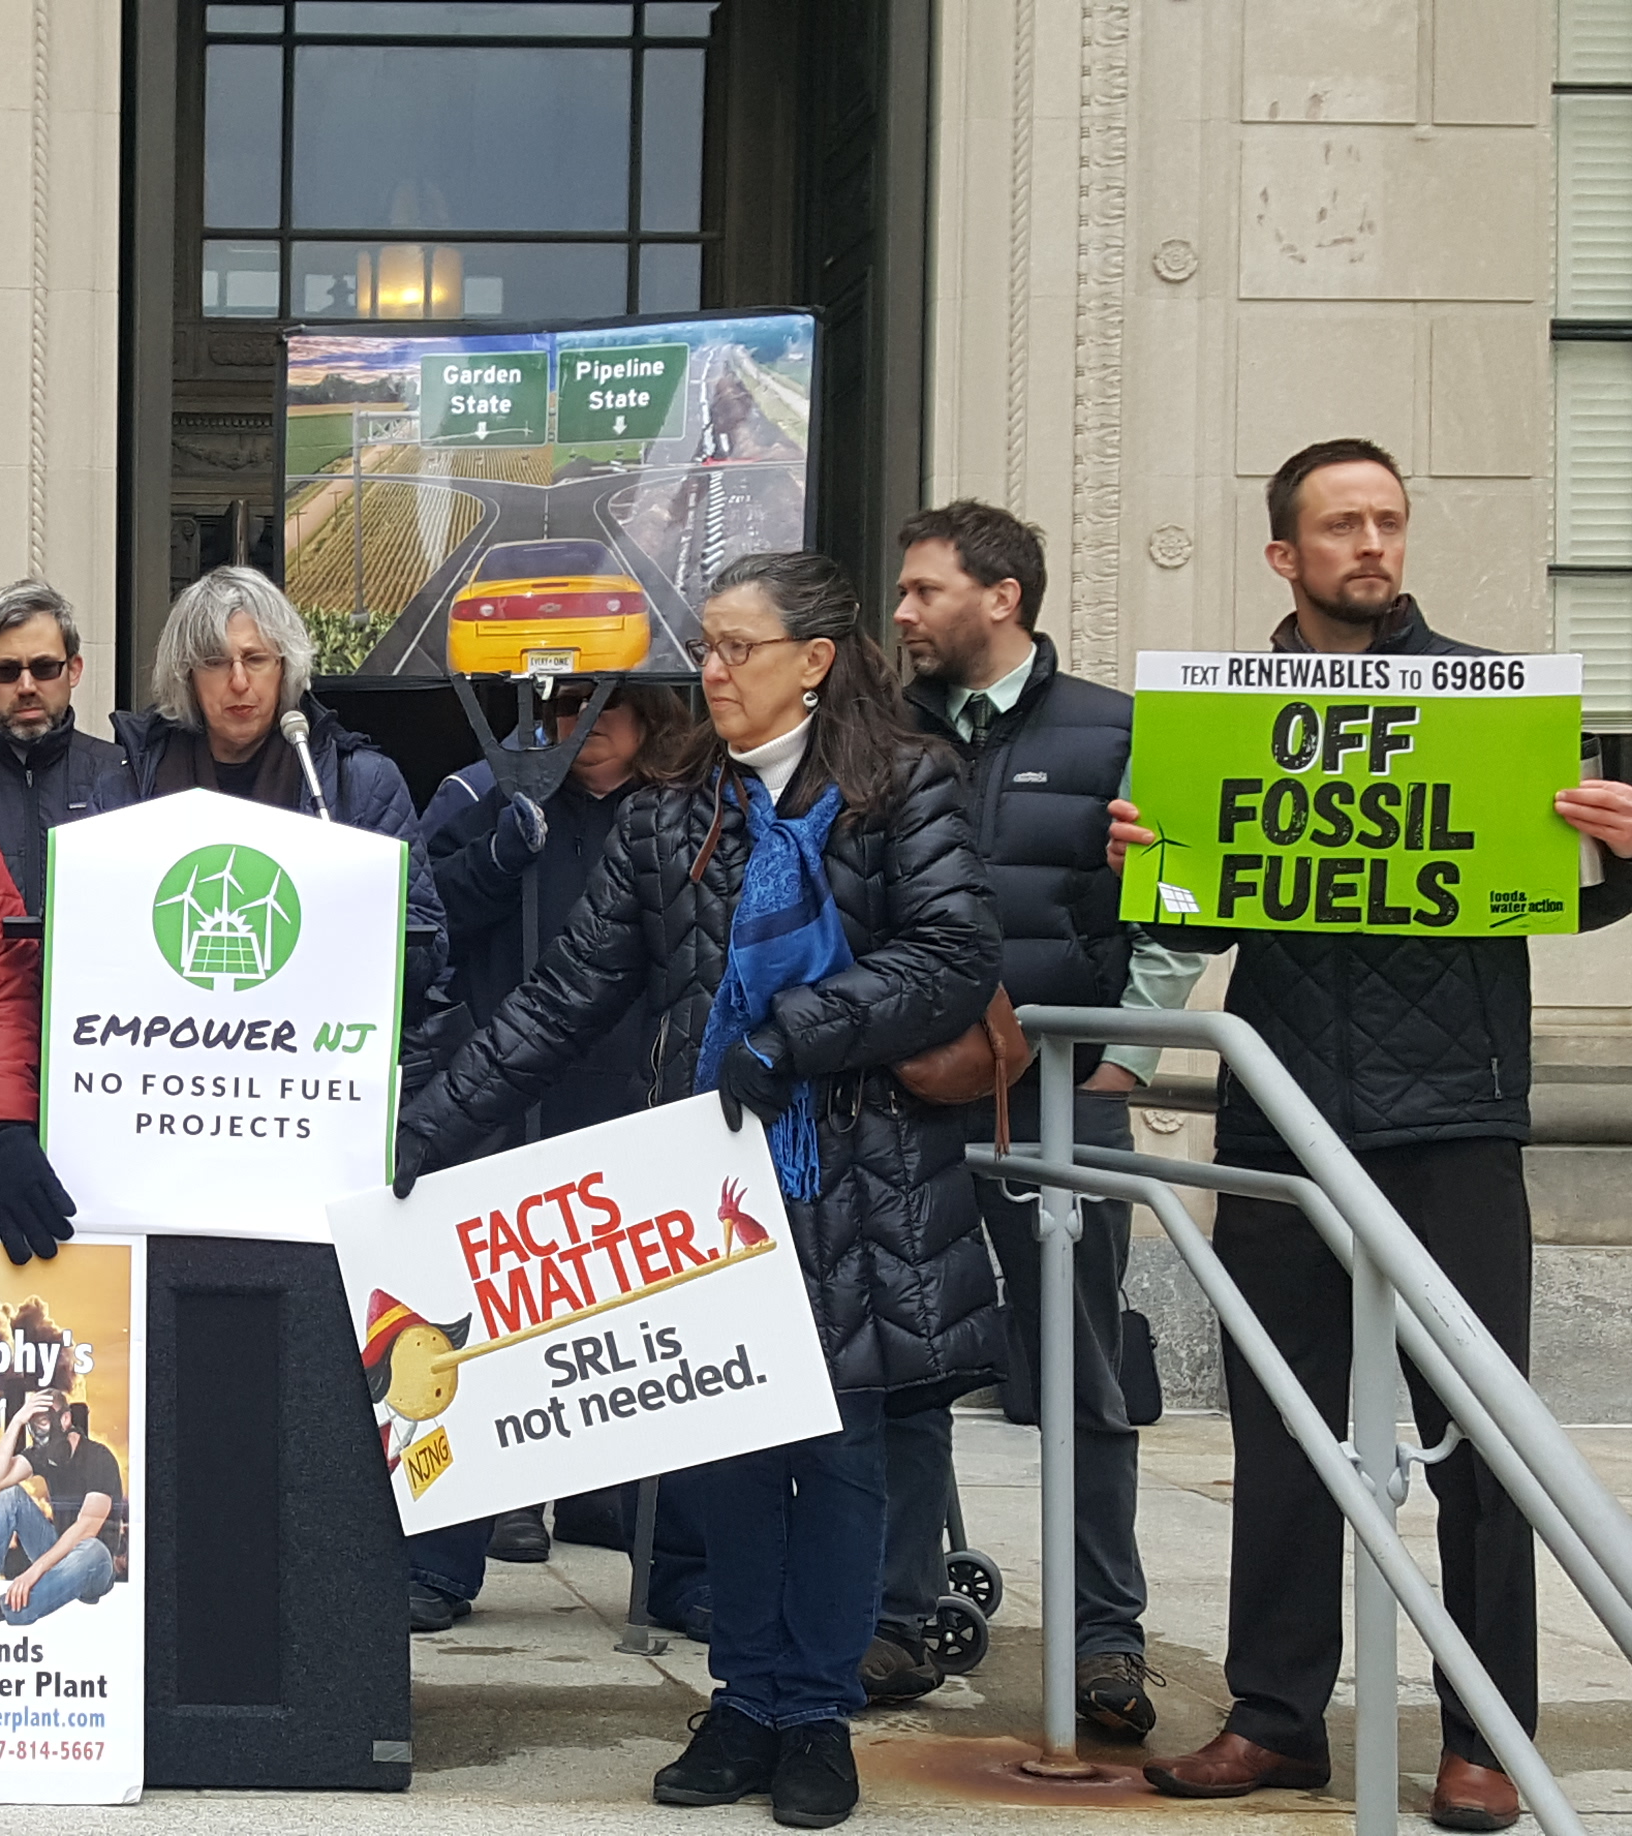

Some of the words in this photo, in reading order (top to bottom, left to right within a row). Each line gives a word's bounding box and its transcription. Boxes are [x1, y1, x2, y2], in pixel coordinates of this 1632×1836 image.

[443, 365, 522, 385] Garden
[576, 360, 665, 385] Pipeline
[450, 395, 512, 415] State
[589, 389, 650, 409] State
[554, 657, 569, 665] ONE
[1181, 666, 1220, 686] TEXT
[1227, 658, 1390, 688] RENEWABLES
[1399, 669, 1422, 690] TO
[1432, 661, 1525, 690] 69866
[1272, 701, 1420, 775] OFF
[1218, 778, 1475, 851] FOSSIL
[1216, 854, 1460, 927] FUELS
[1490, 903, 1526, 913] water
[1528, 898, 1563, 912] action
[72, 1014, 298, 1053] EMPOWER
[313, 1022, 377, 1054] NJ
[74, 1072, 123, 1094] NO
[142, 1074, 261, 1099] FOSSIL
[280, 1078, 362, 1102] FUEL
[135, 1113, 311, 1139] PROJECTS
[456, 1171, 621, 1280] FACTS
[473, 1210, 720, 1339] MATTER.
[543, 1332, 637, 1388] SRL
[641, 1322, 683, 1361] is
[494, 1397, 571, 1448] not
[578, 1344, 767, 1428] needed.
[407, 1434, 450, 1483] NJNG
[35, 1673, 108, 1698] Plant
